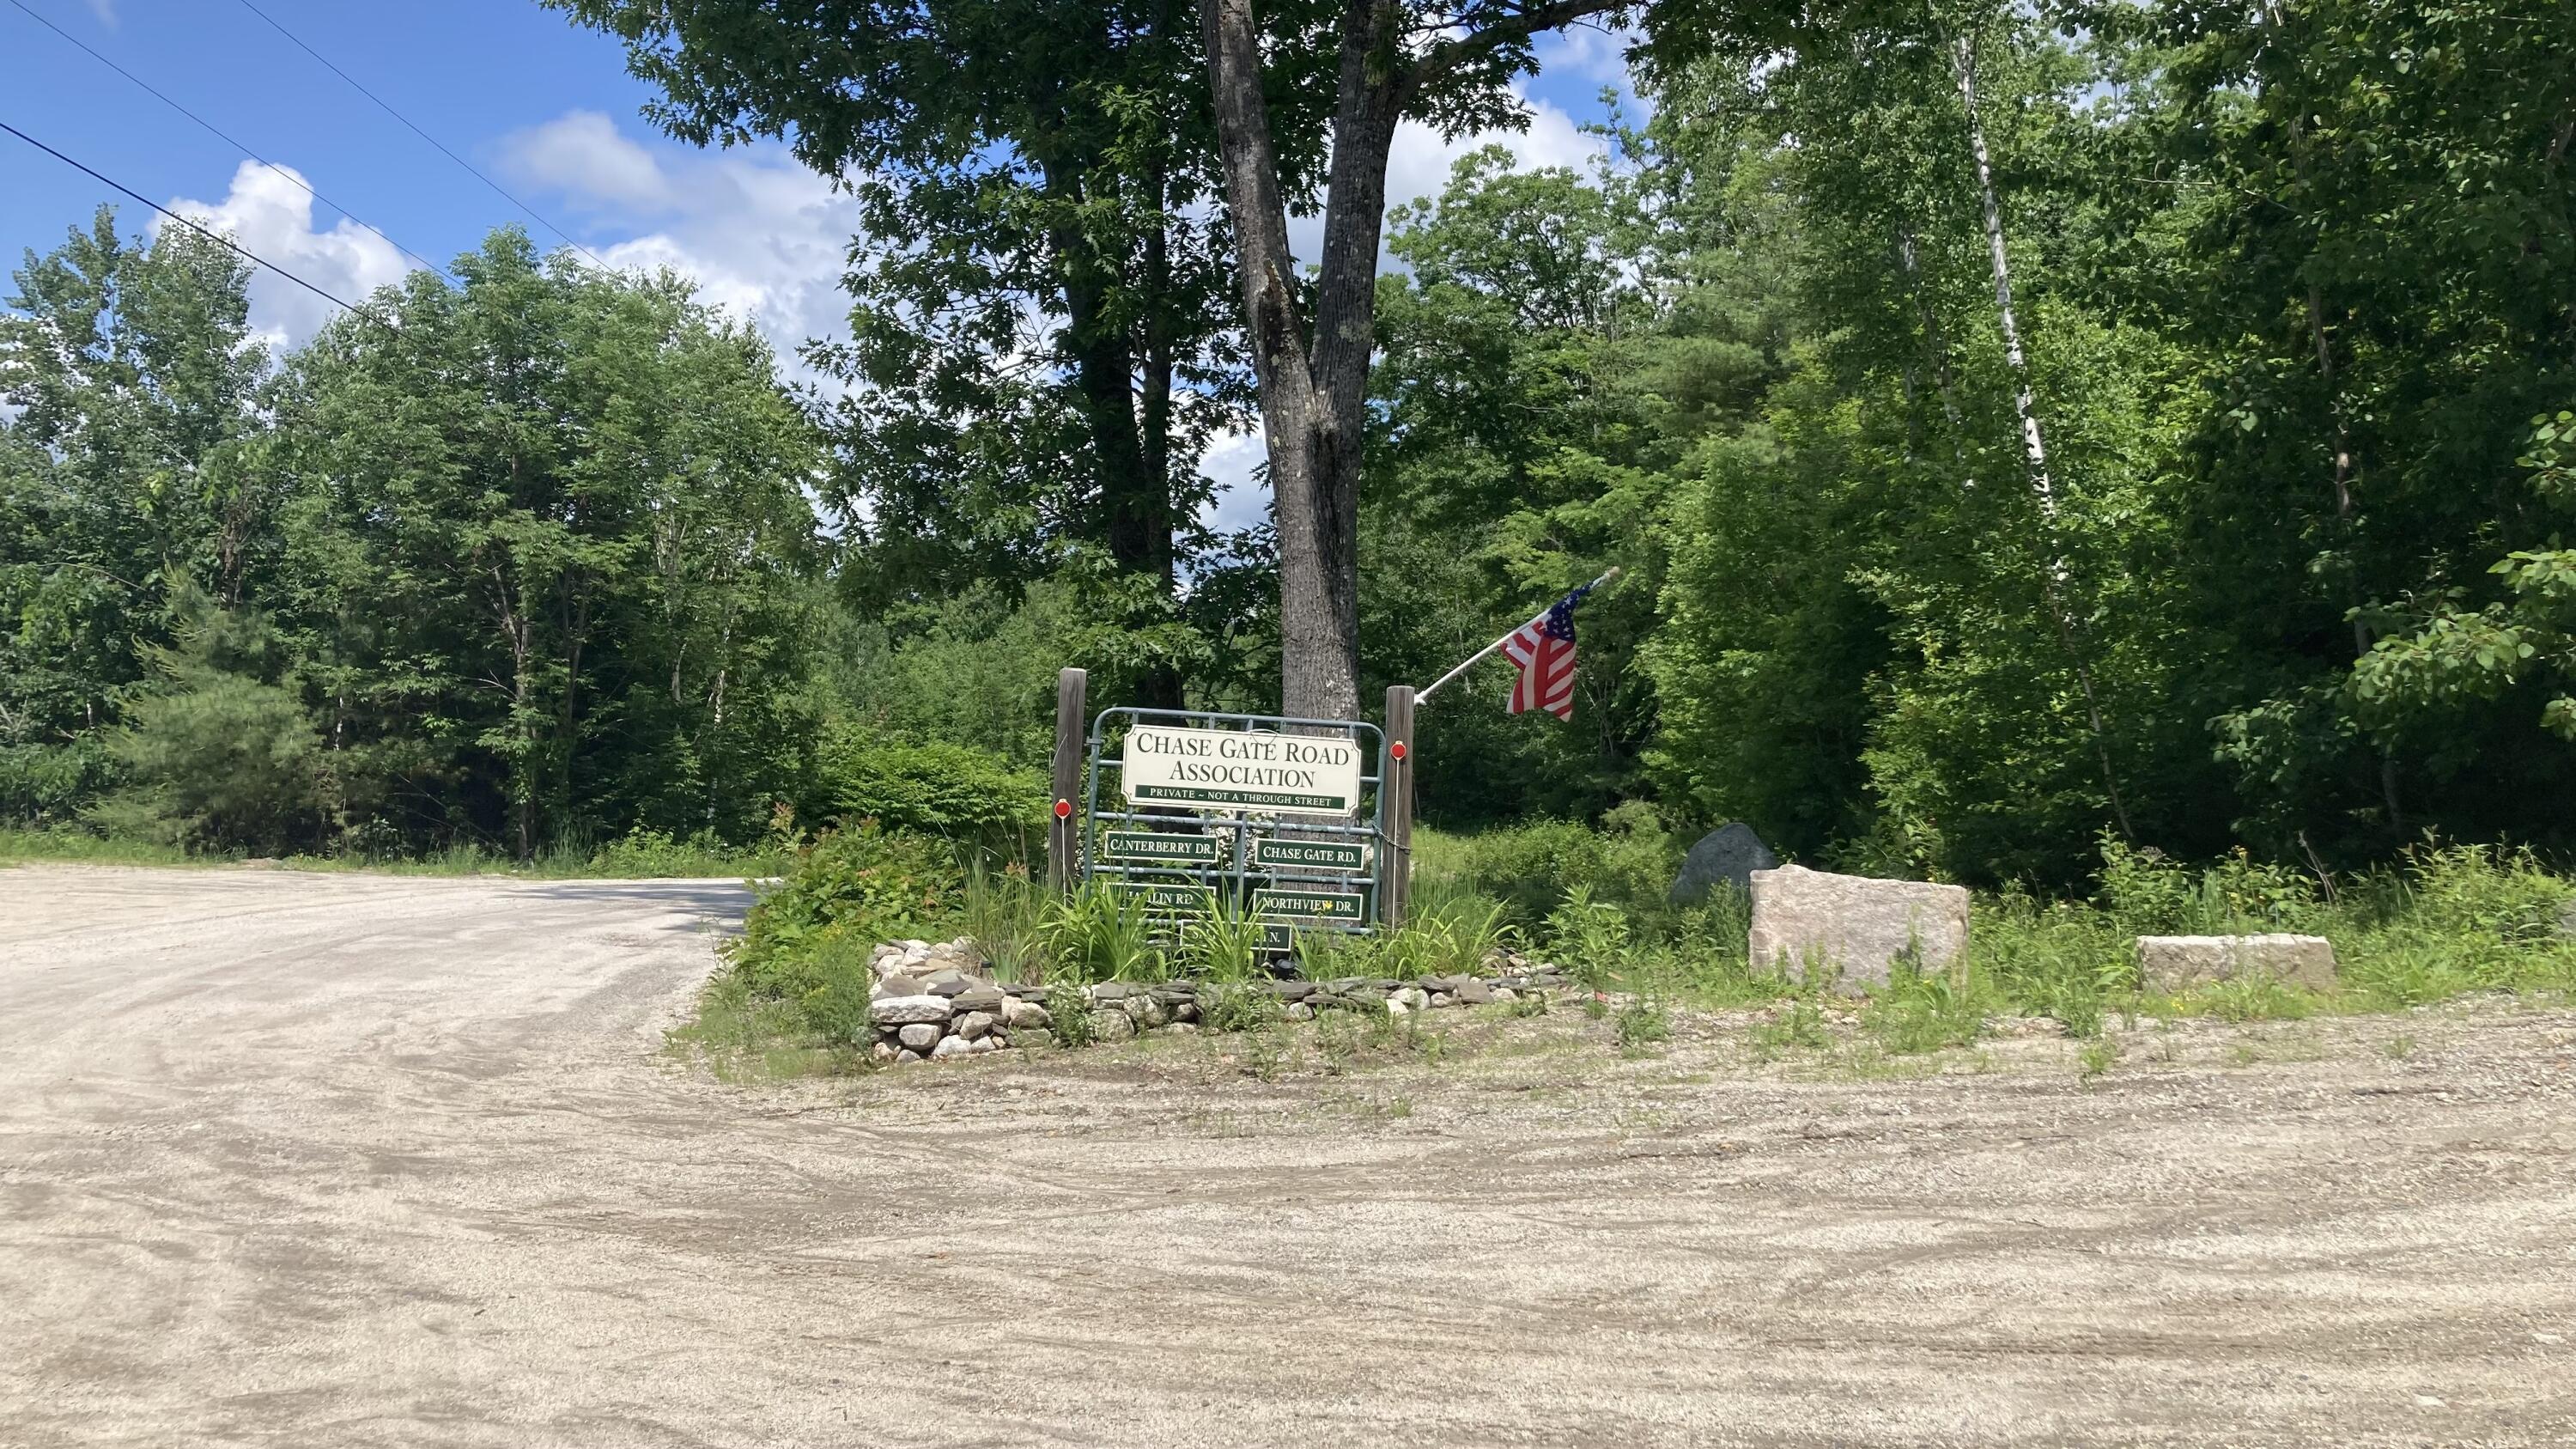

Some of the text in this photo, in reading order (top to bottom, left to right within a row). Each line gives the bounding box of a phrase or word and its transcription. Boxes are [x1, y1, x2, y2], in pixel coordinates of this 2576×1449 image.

[1137, 732, 1349, 766] CHASE GATE ROAD
[1169, 760, 1316, 788] ASSOCIATION
[1149, 788, 1195, 800] PRIVATE
[1207, 791, 1228, 801] NOT
[1231, 793, 1239, 801] A
[1242, 793, 1291, 805] THROUGH
[1294, 796, 1333, 807] STREET
[1109, 838, 1214, 855] CANTERBERRY DR.
[1262, 846, 1357, 863] CHASE GATE RD.
[1176, 892, 1194, 905] RD
[1335, 900, 1355, 912] DR.
